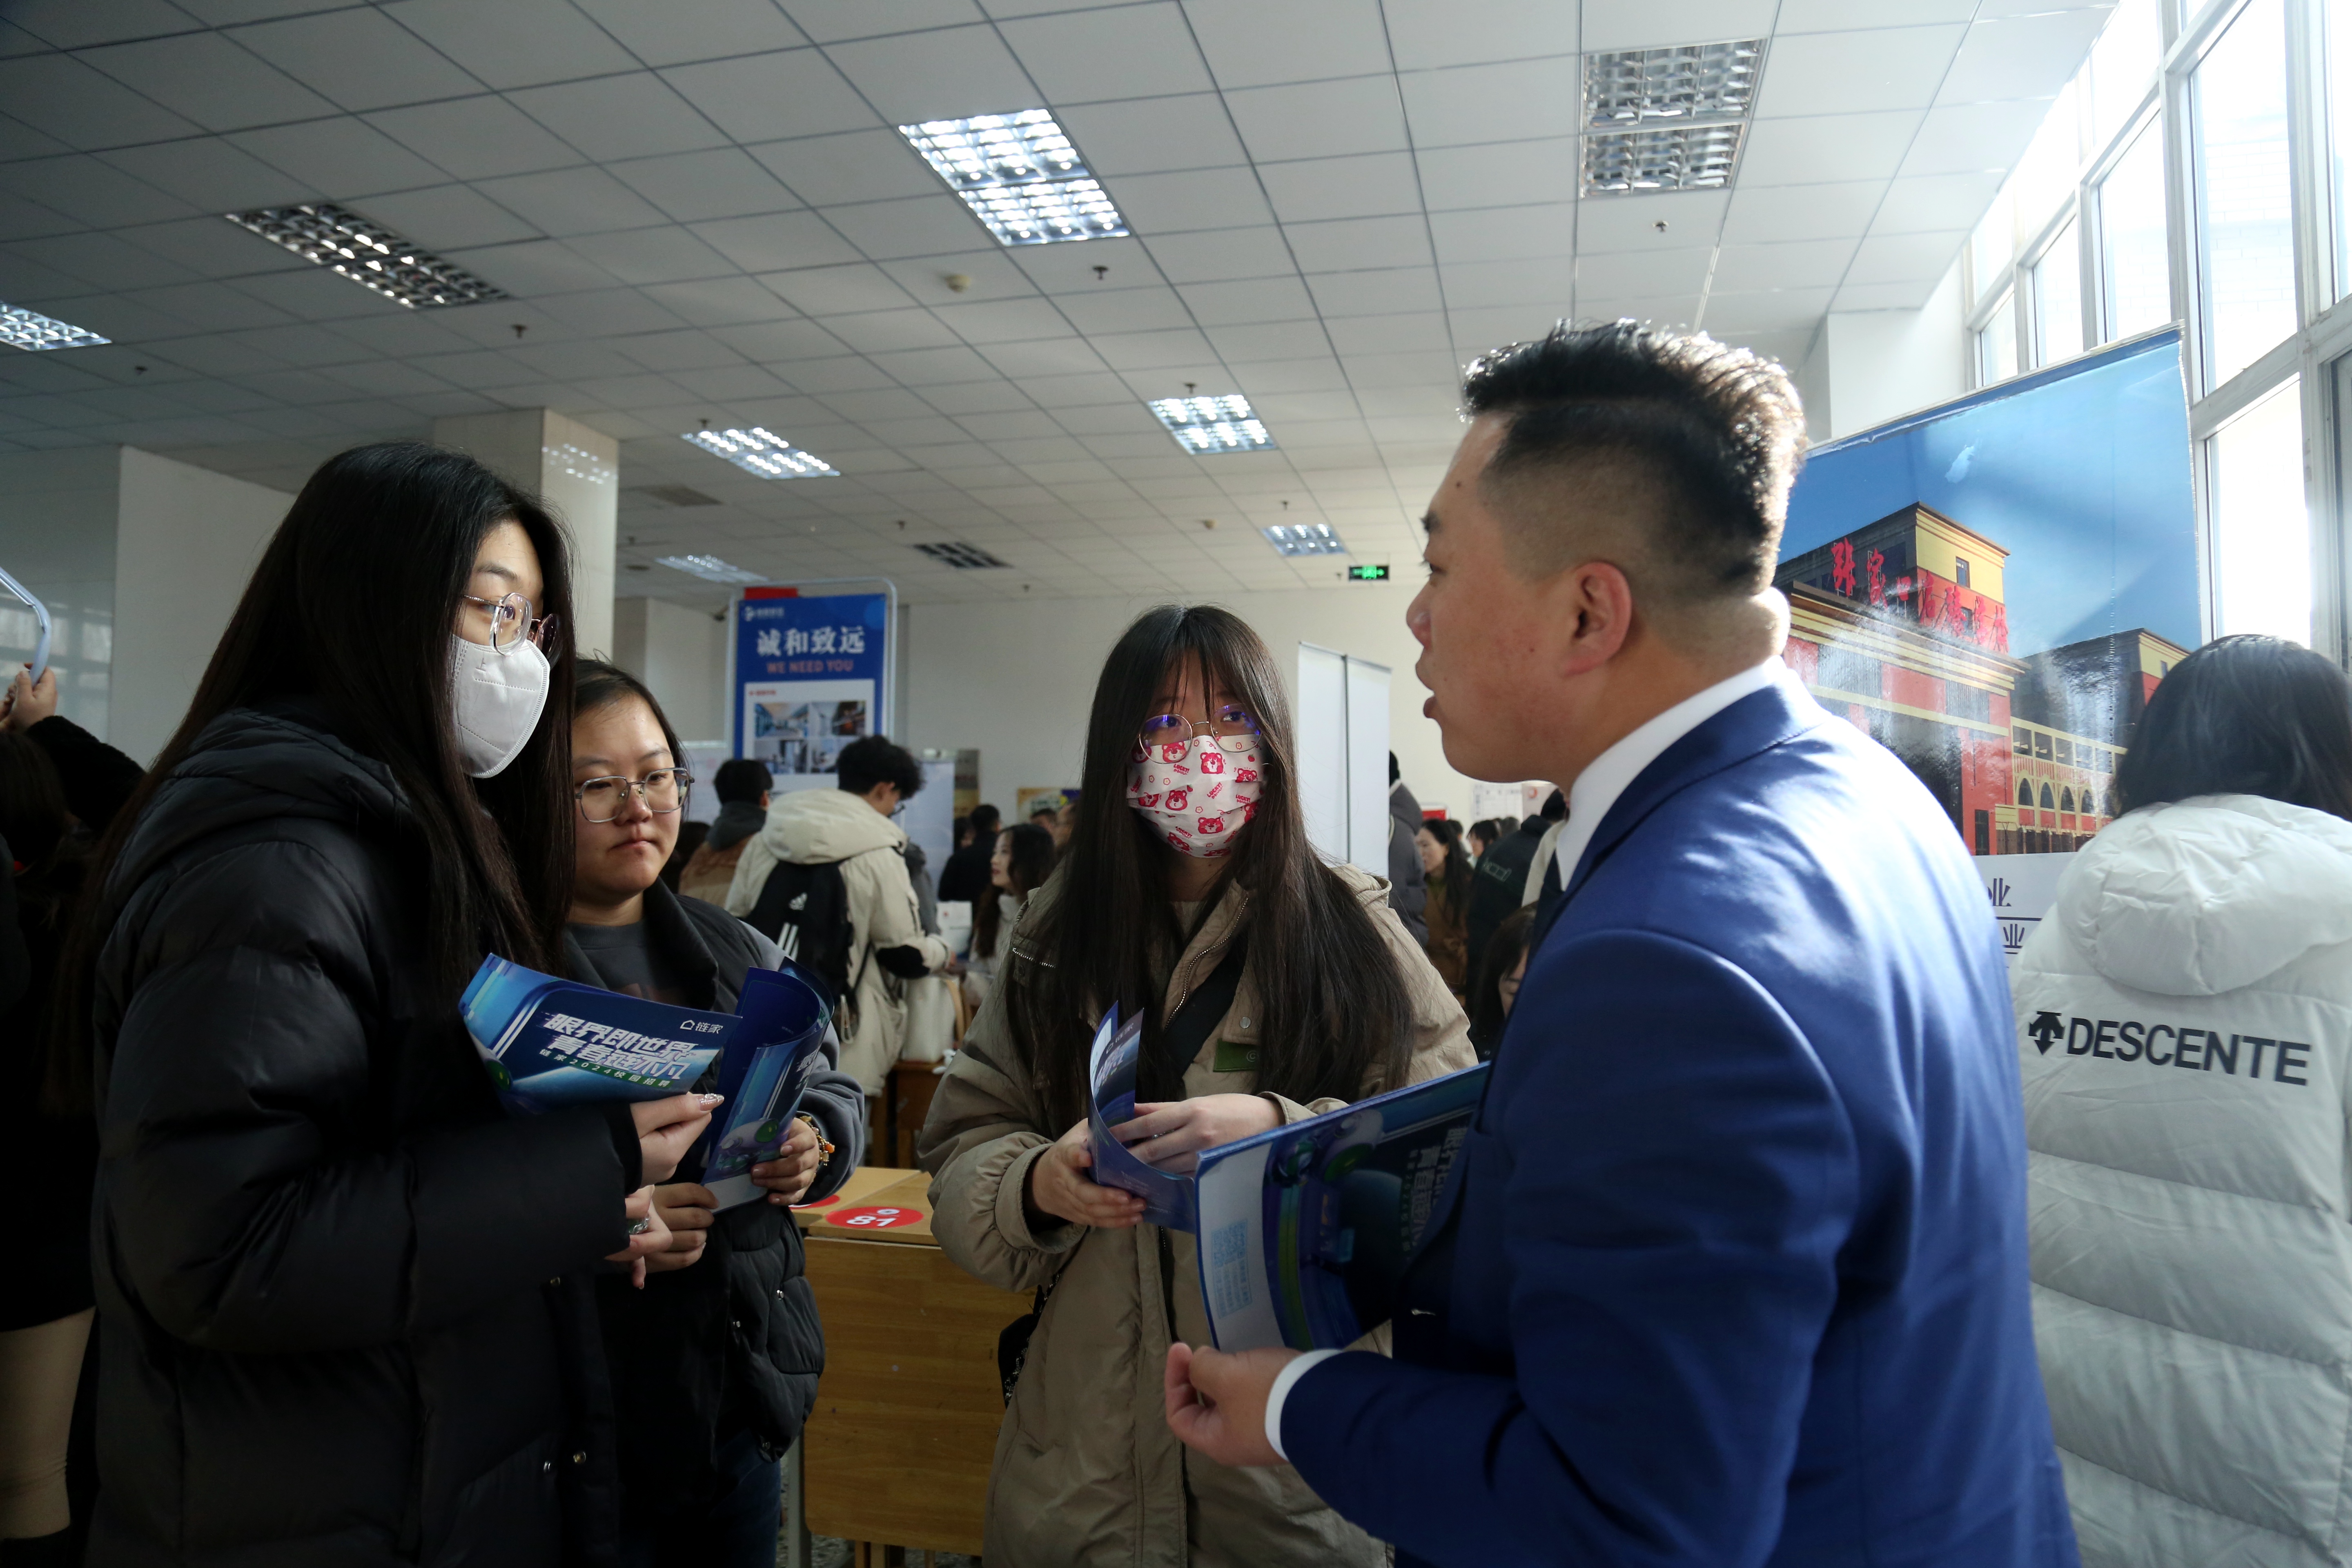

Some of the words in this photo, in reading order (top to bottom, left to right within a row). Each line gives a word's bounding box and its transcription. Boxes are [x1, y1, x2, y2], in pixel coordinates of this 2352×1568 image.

[767, 662, 785, 673] WE
[789, 660, 824, 673] NEED
[826, 659, 854, 672] YOU
[543, 1013, 698, 1061] 眼界即世界
[695, 1022, 724, 1034] 链家
[2067, 1017, 2310, 1086] DESCENTE
